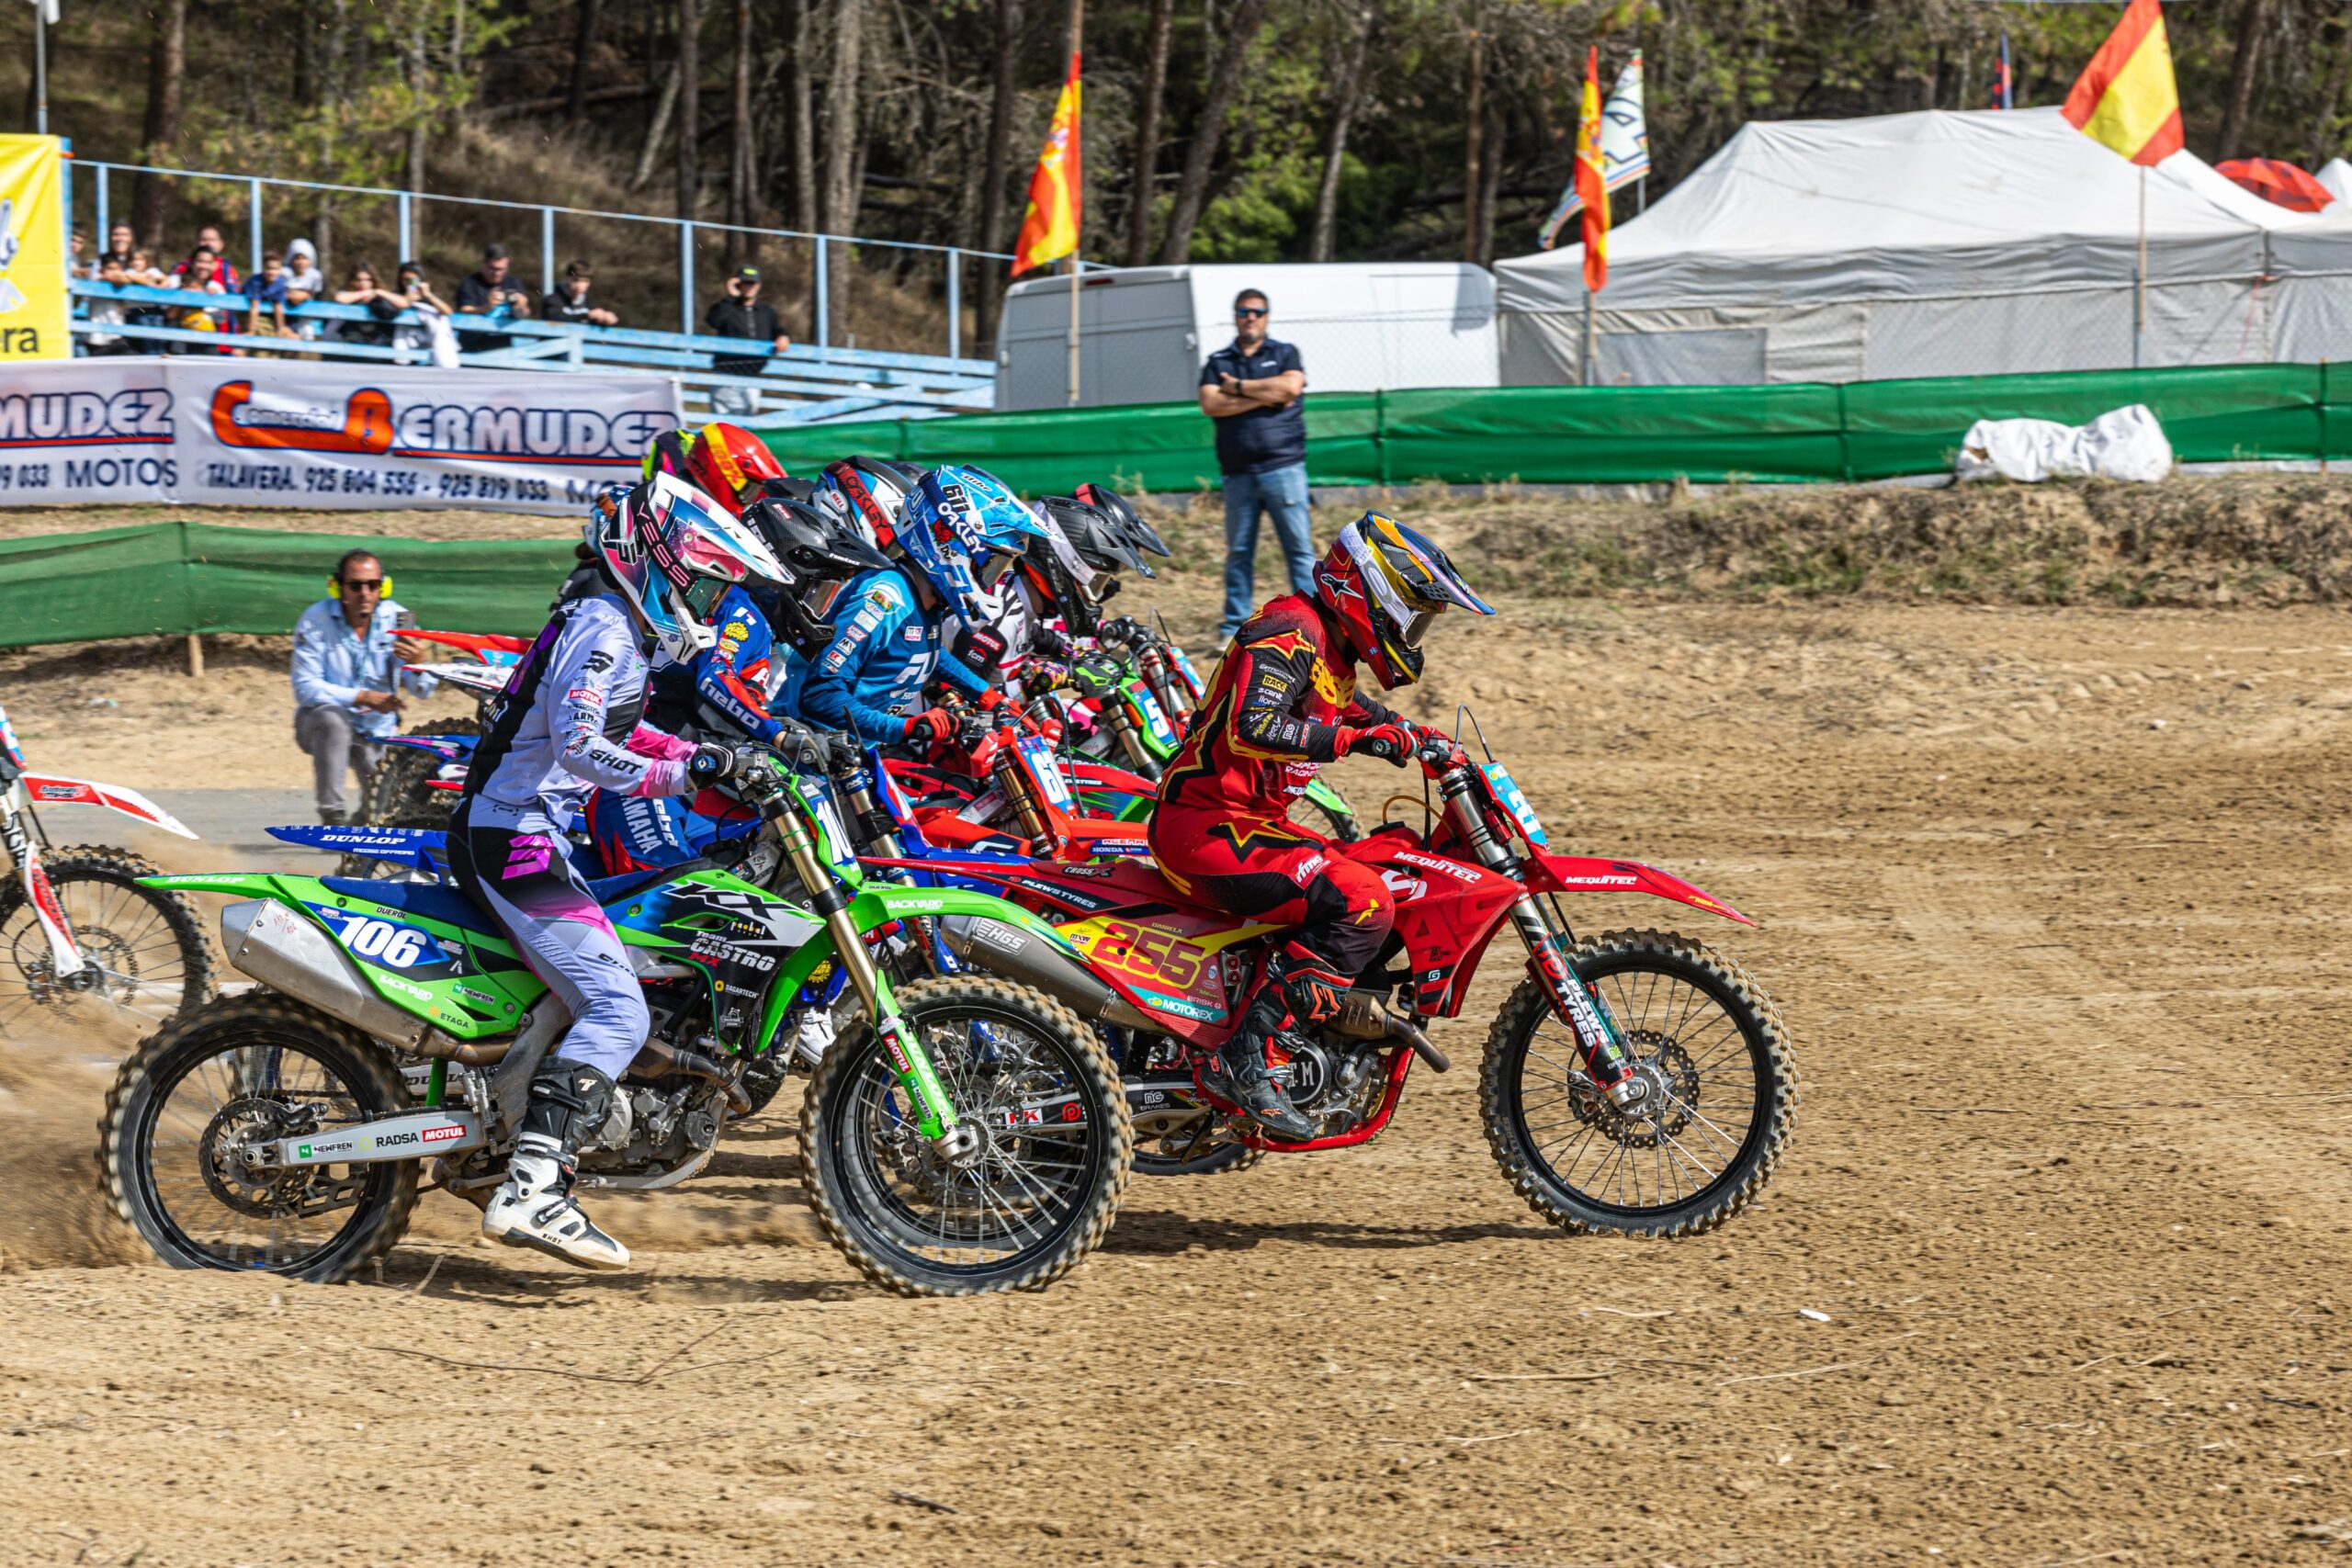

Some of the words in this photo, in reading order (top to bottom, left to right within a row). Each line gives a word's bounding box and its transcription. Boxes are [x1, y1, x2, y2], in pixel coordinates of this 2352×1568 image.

[0, 326, 39, 353] ra
[65, 458, 178, 488] MOTOS
[831, 492, 844, 509] BELL
[846, 476, 888, 529] OAKLEY
[938, 502, 987, 554] OAKLEY
[973, 632, 1002, 650] MOTUL
[571, 690, 602, 705] MOTUL
[700, 677, 761, 729] hebo
[589, 749, 643, 774] SHOT
[620, 795, 663, 854] AMAHA
[652, 798, 678, 847] ebo
[321, 834, 406, 845] DUNLOP
[1393, 852, 1483, 884] MEQUITEC
[1566, 874, 1638, 885] MEQUITEC
[887, 899, 944, 909] BACKYARD
[1022, 879, 1062, 895] PLEWS
[1061, 891, 1097, 908] TYRES
[338, 916, 427, 968] 106
[695, 931, 728, 942] Team
[688, 952, 721, 967] MX
[690, 937, 776, 971] CASTRO
[1093, 921, 1205, 987] 255
[1162, 999, 1214, 1021] MOTOREX
[1186, 995, 1214, 1007] BRISK
[1567, 978, 1609, 1045] PLEWS
[440, 1012, 469, 1028] ETAGA
[1556, 982, 1597, 1048] TYRES
[886, 1037, 910, 1072] MOTUL
[1139, 1102, 1170, 1111] BRAKES
[313, 1141, 353, 1153] NEWFREN
[376, 1133, 419, 1147] RADSA
[424, 1126, 465, 1142] MOTUL
